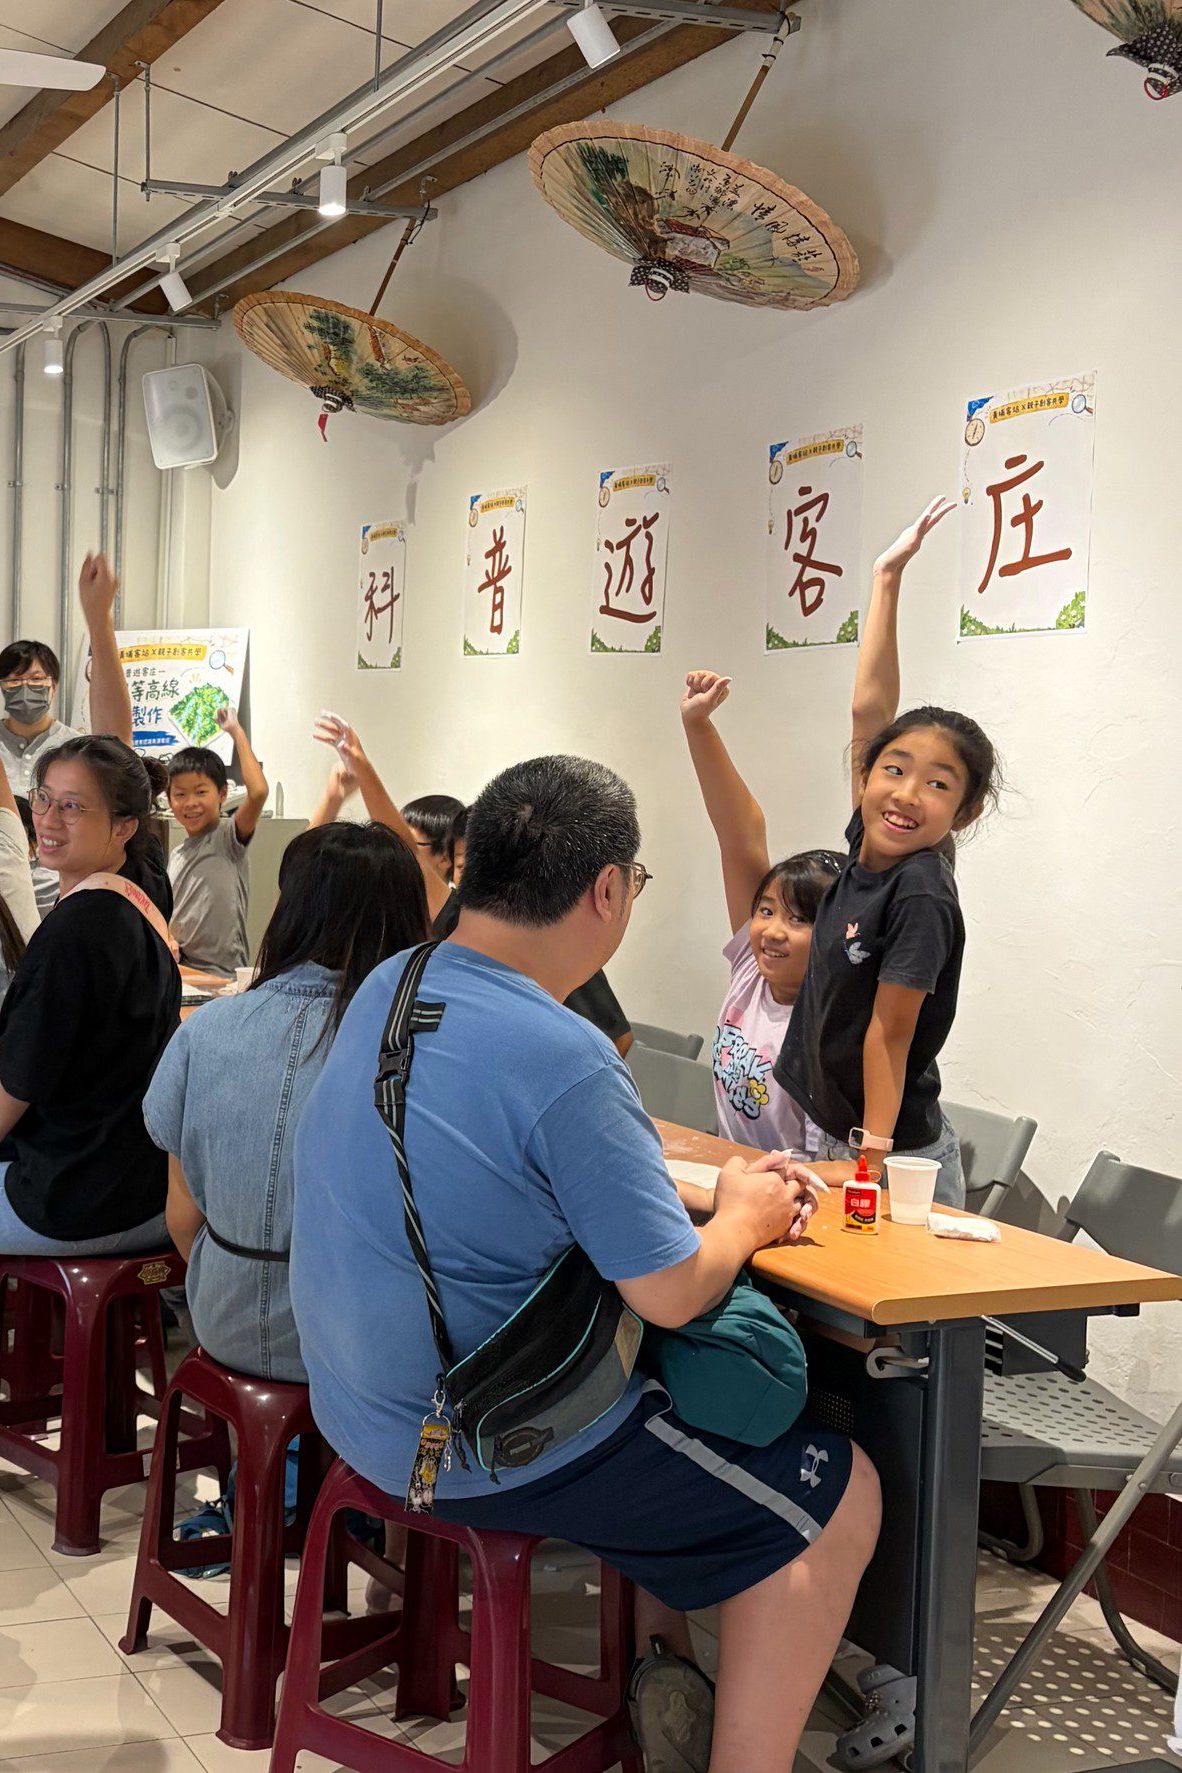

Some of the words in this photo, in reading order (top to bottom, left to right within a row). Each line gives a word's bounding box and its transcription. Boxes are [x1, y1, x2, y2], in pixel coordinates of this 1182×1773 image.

[478, 524, 513, 634] 普
[599, 512, 659, 624] 遊
[786, 485, 843, 617] 客
[977, 454, 1073, 595] 庄
[364, 565, 401, 645] 科
[131, 678, 180, 702] 等高線
